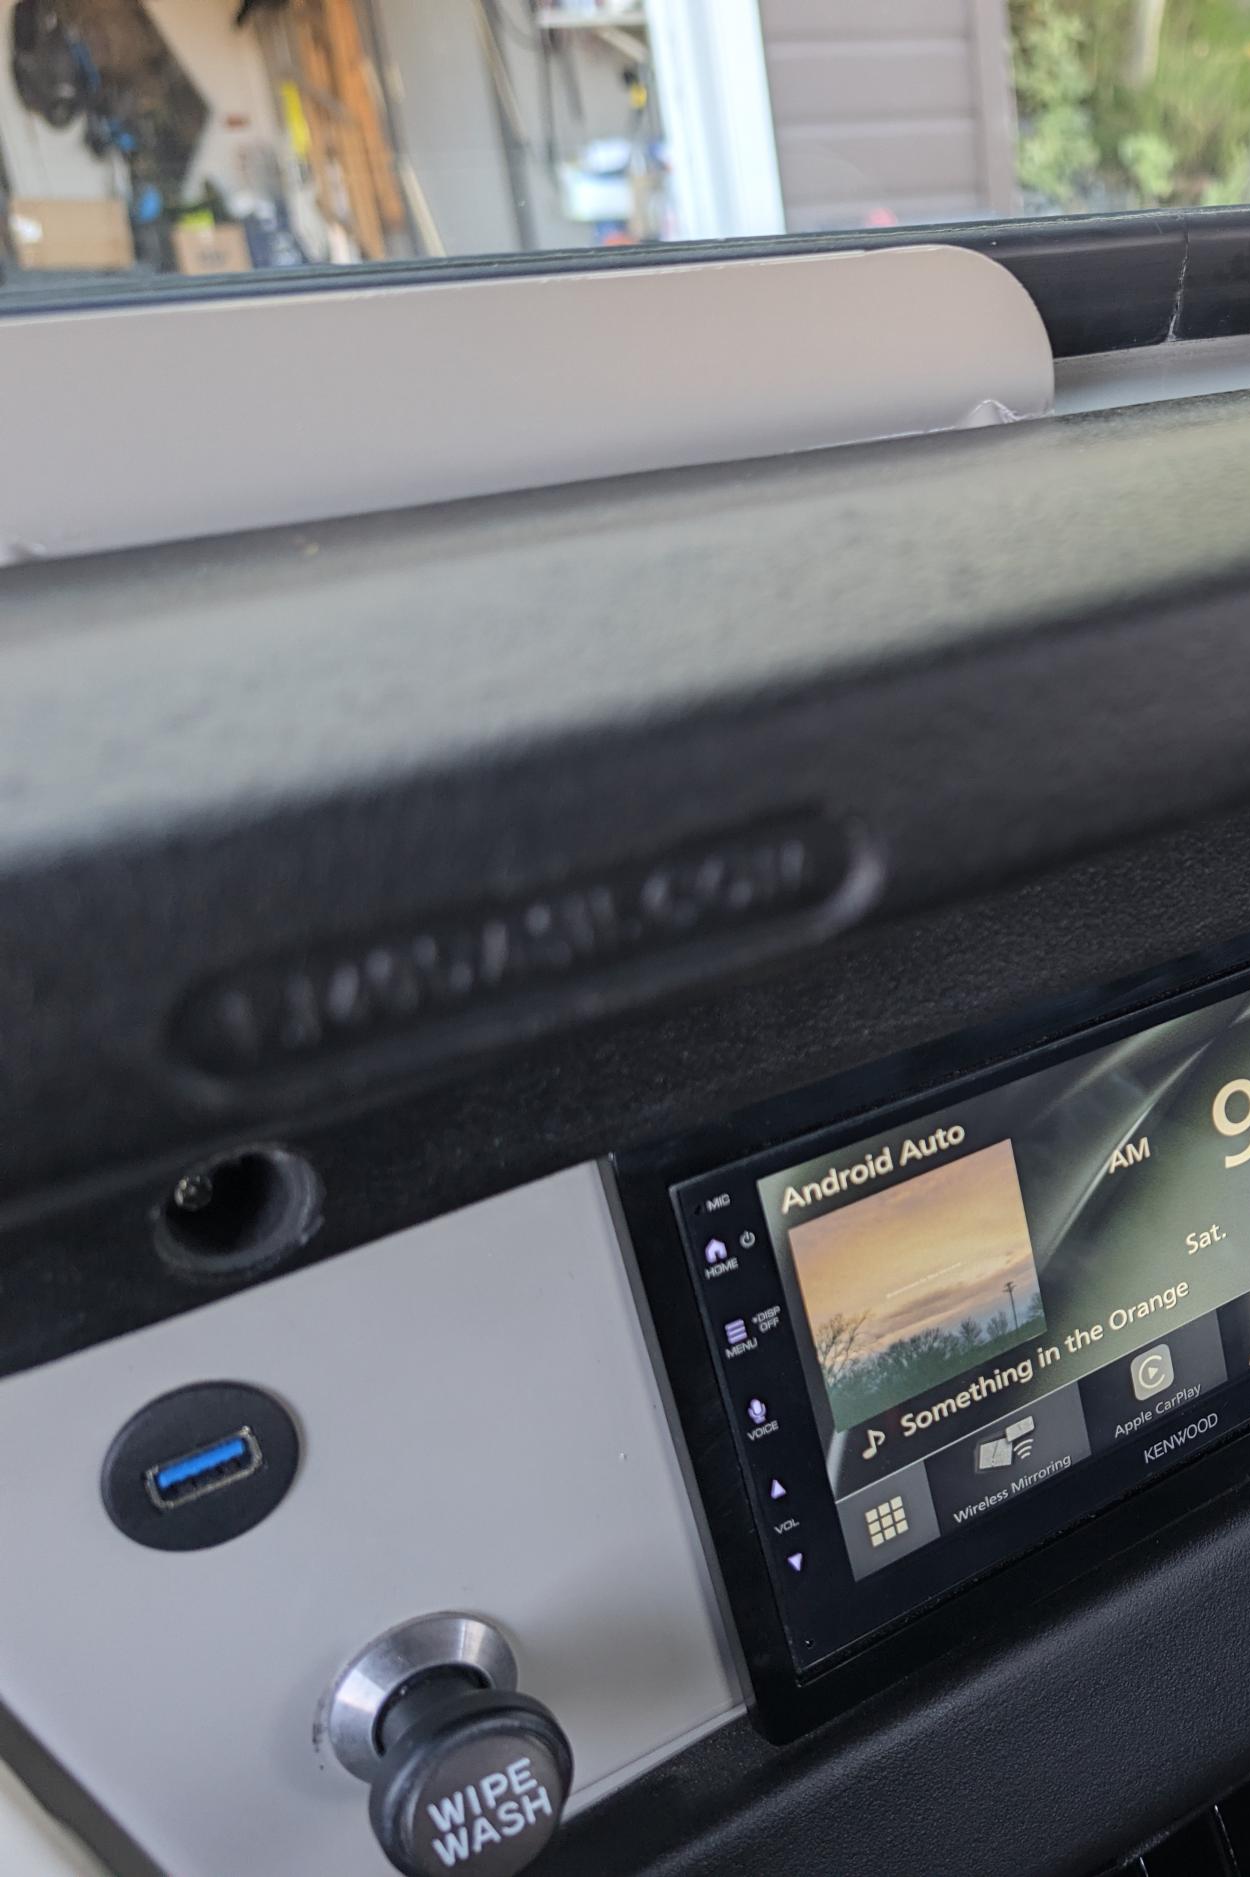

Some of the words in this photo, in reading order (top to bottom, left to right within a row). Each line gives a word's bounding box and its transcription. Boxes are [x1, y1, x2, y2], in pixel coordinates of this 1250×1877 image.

[781, 1147, 894, 1215] Android
[900, 1124, 965, 1167] Auto
[1108, 1136, 1151, 1174] AM
[706, 1193, 731, 1212] MIC
[1185, 1223, 1228, 1255] Sat.
[704, 1257, 739, 1280] HOME
[759, 1316, 780, 1333] OFF
[725, 1336, 759, 1359] MENU
[900, 1358, 1034, 1438] Something
[1037, 1344, 1060, 1370] in
[1064, 1322, 1104, 1355] the
[1107, 1279, 1191, 1331] Orange
[1114, 1408, 1153, 1439] Apple
[1155, 1383, 1202, 1416] CarPlay
[747, 1420, 780, 1442] VOICE
[1143, 1412, 1220, 1465] KENWOOD
[953, 1486, 1009, 1525] Wireless
[1010, 1454, 1072, 1495] Mirroring
[774, 1517, 800, 1536] VOL
[427, 1756, 538, 1833] WIPE
[431, 1786, 553, 1868] WASH
